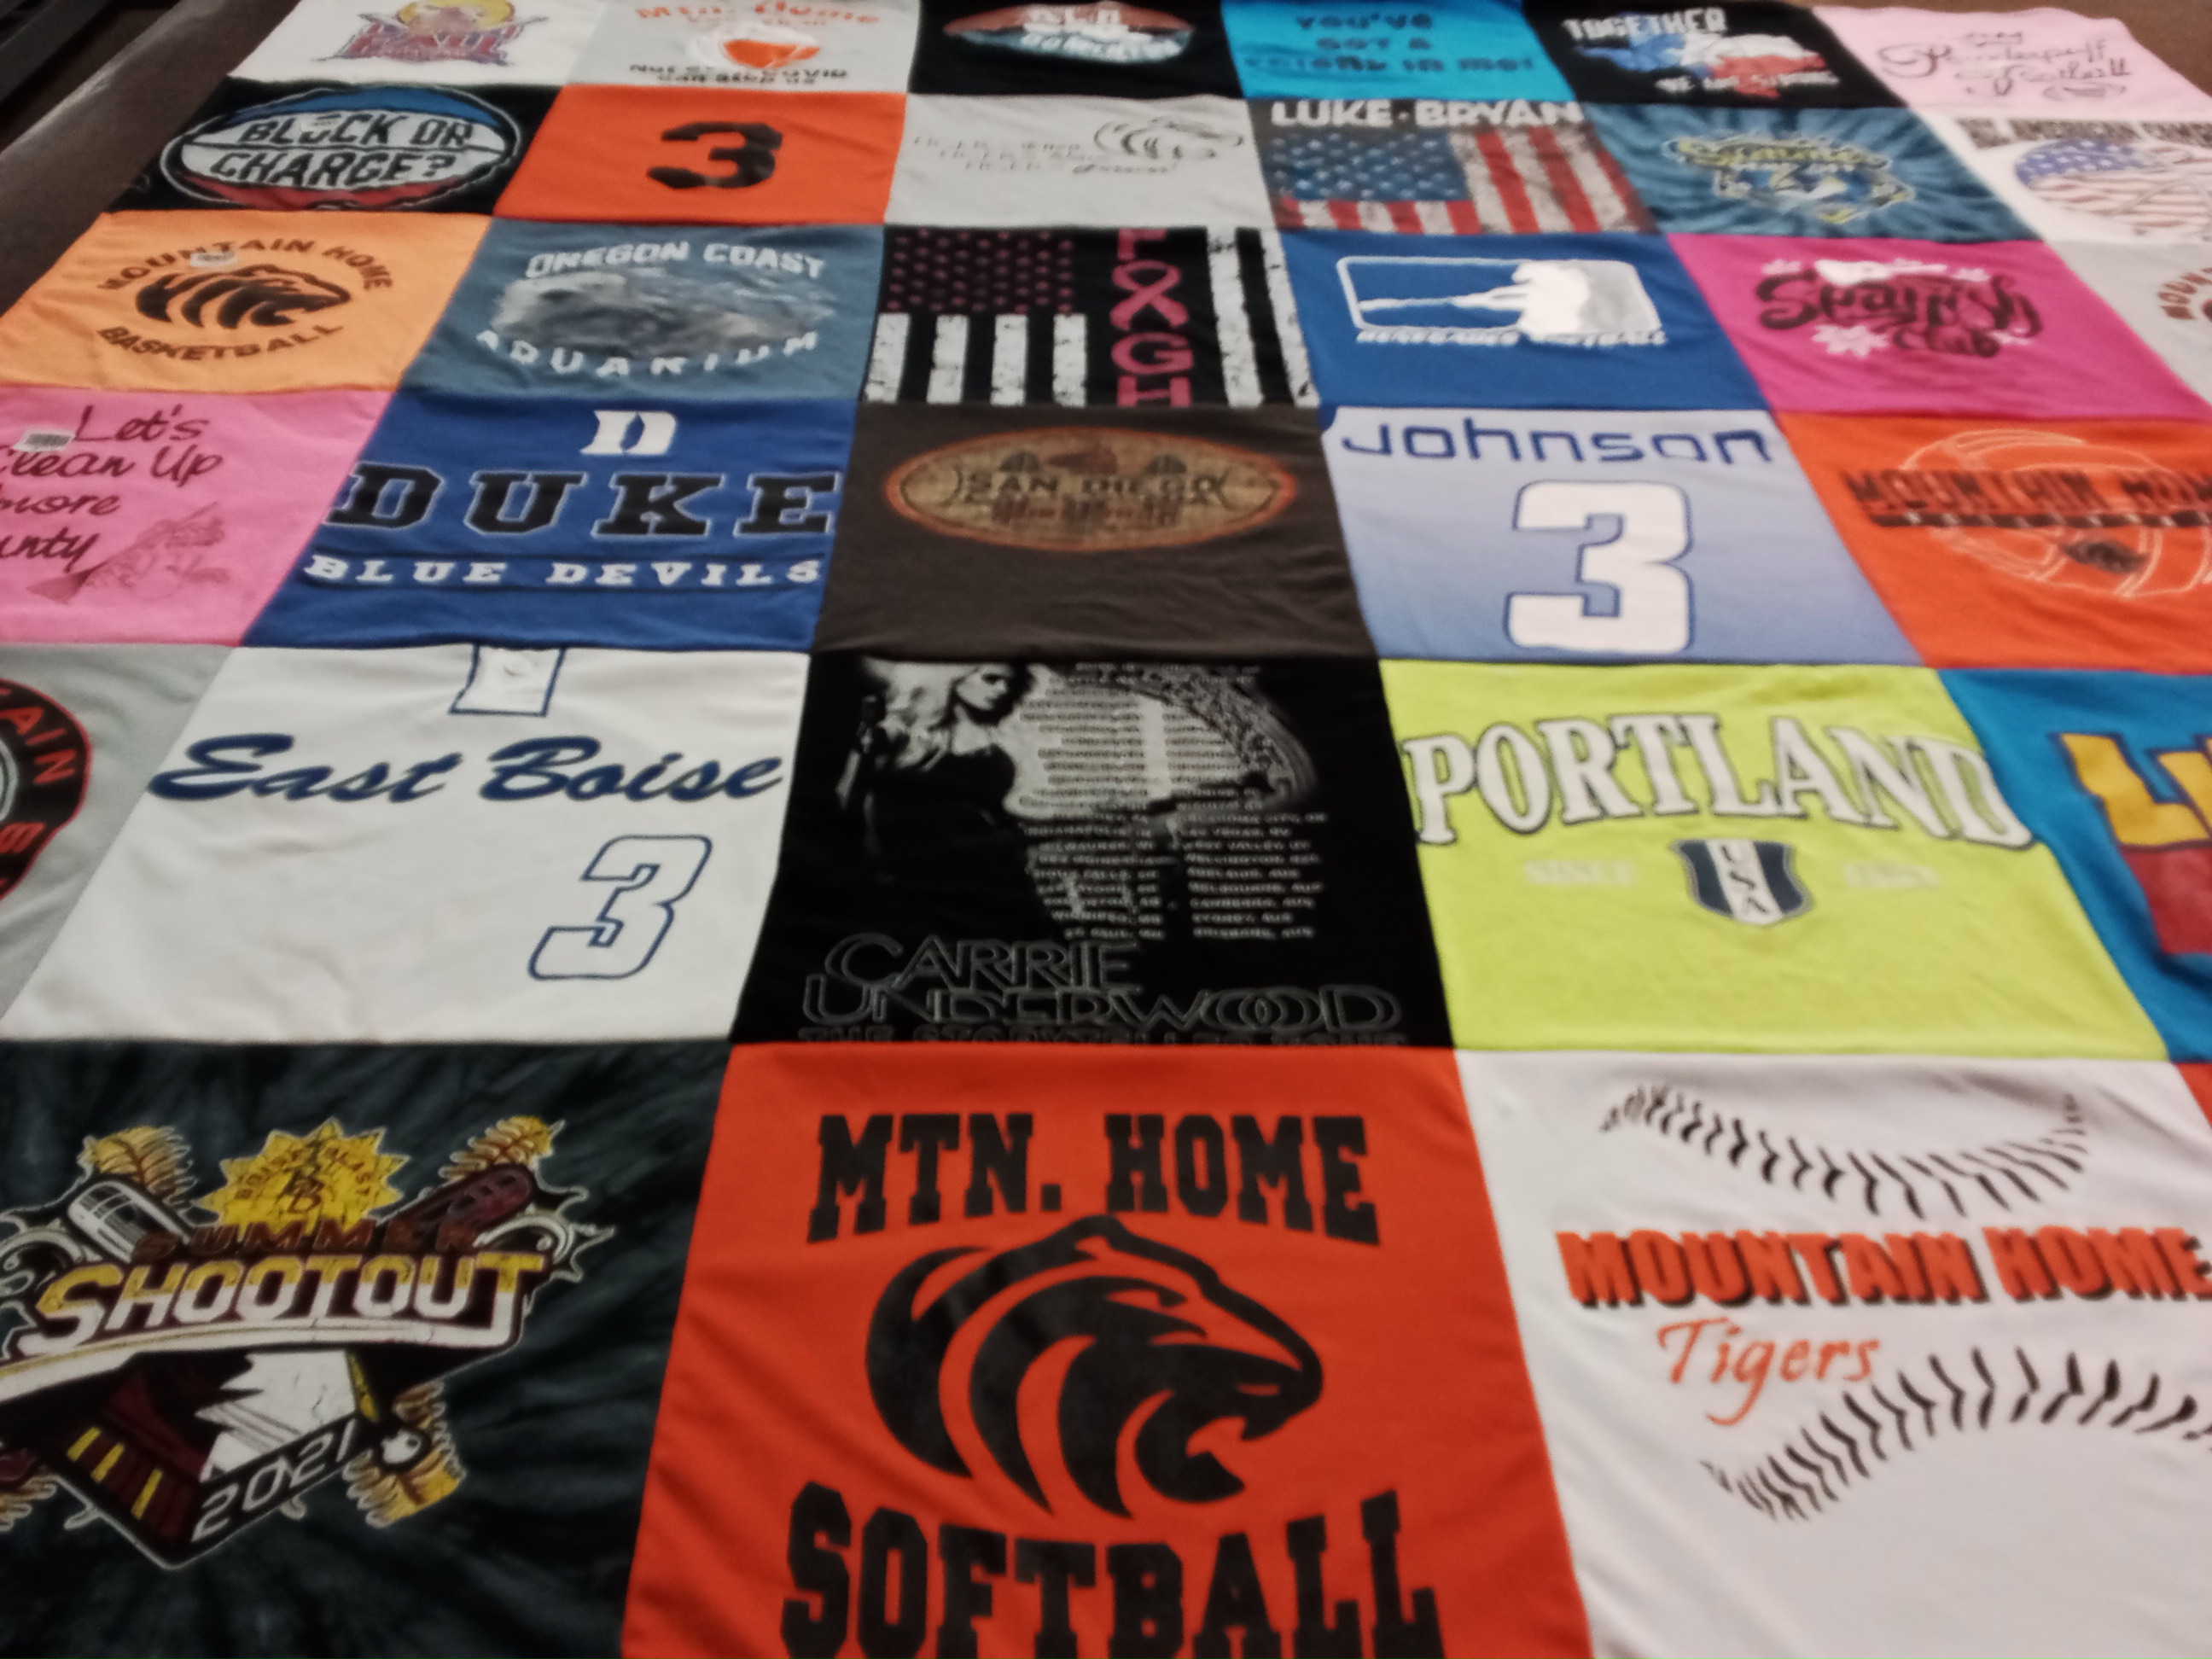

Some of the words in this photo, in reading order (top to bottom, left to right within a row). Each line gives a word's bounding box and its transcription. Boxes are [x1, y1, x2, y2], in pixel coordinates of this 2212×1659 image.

[409, 119, 474, 148] OR
[1270, 99, 1392, 128] LUKE
[1414, 98, 1585, 126] BRYAN
[209, 150, 457, 189] CHARGE?
[646, 120, 783, 189] 3
[322, 245, 394, 291] HOME
[526, 241, 690, 279] OREGON
[702, 242, 824, 279] COAST
[96, 323, 345, 362] BASKETBALL
[475, 329, 819, 376] AQUARIUM
[74, 403, 212, 443] Let's
[149, 444, 224, 488] Up
[323, 460, 843, 540] DUKE
[303, 553, 509, 585] BLUE
[545, 558, 822, 586] DEVILS
[1501, 480, 1697, 655] 3
[145, 731, 463, 804] East
[478, 734, 785, 802] Boise
[1401, 712, 2038, 848] PORTLAND
[526, 833, 714, 981] 3
[824, 932, 1142, 993] CARRIE
[801, 973, 1404, 1033] UNDERWOOD
[806, 1113, 1063, 1246] MTN.
[1103, 1113, 1382, 1247] HOME
[1555, 1227, 1991, 1308] MOUNTAIN
[1981, 1225, 2212, 1301] HOME
[17, 1252, 548, 1359] SHOOTOUT
[1656, 1317, 1881, 1427] Tigers
[190, 1415, 358, 1545] 2021
[779, 1480, 1447, 1659] SOFTBALL
